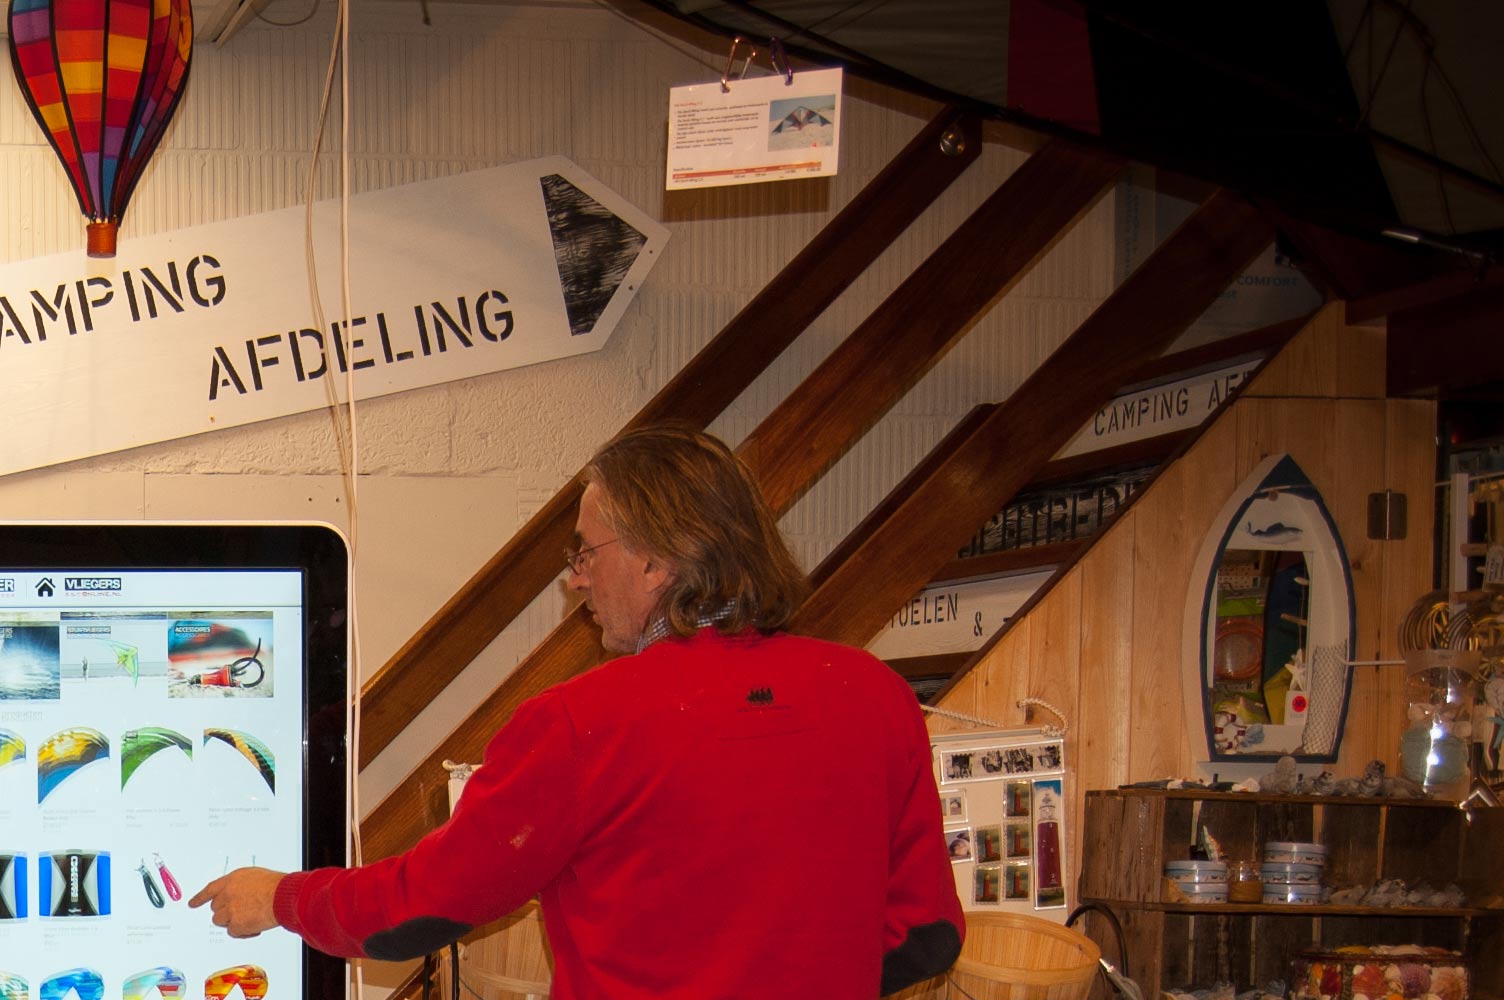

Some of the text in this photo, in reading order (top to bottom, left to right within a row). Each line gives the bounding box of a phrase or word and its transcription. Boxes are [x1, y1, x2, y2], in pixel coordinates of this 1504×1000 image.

[208, 289, 516, 402] AFDELING
[1093, 386, 1190, 438] CAMPING
[65, 578, 122, 591] VLIEGERS
[973, 611, 984, 638] &
